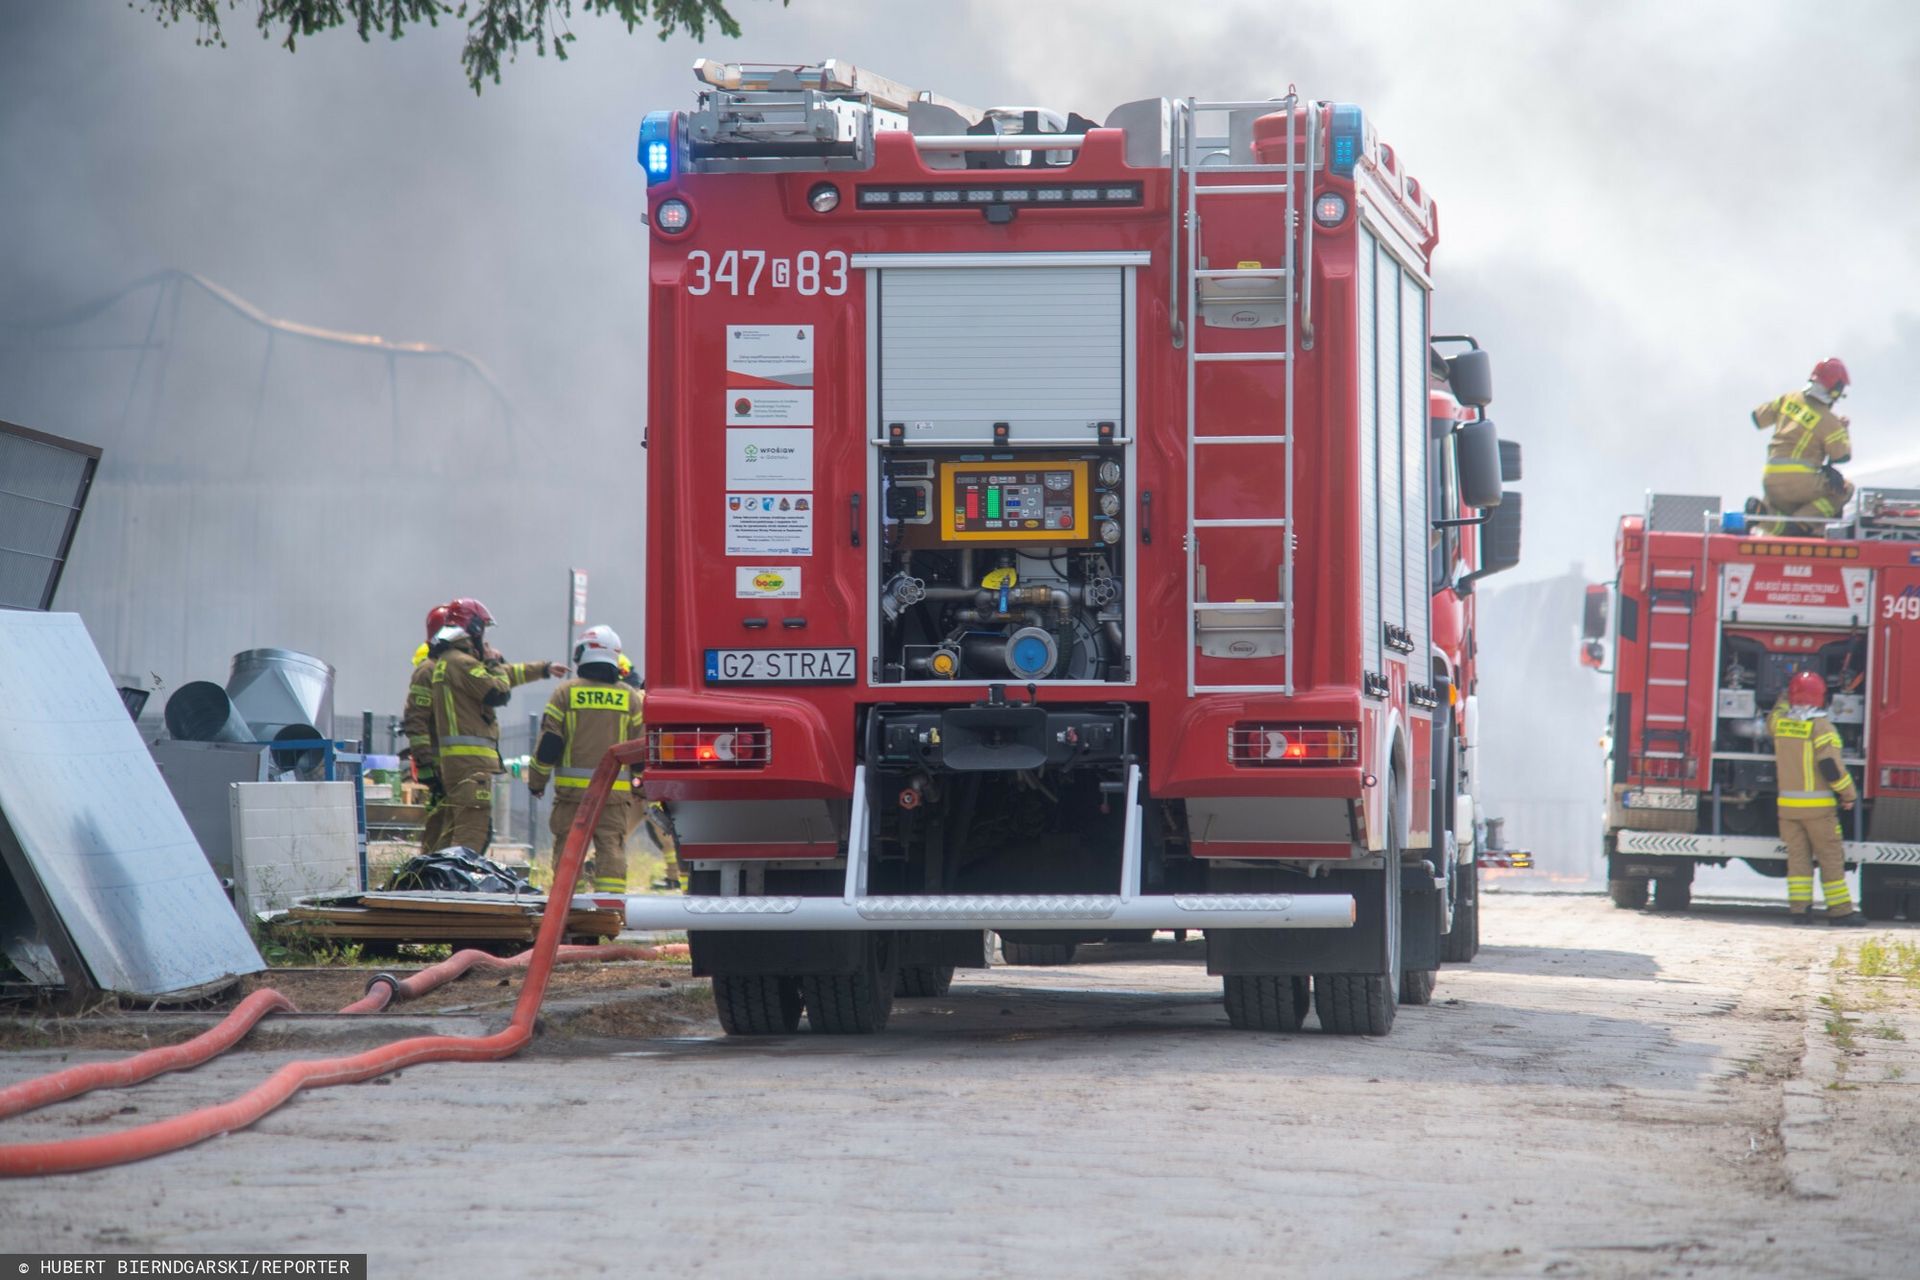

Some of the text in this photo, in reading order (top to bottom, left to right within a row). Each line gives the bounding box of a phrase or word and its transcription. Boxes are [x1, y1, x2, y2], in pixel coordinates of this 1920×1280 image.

[687, 250, 765, 296] 347
[797, 250, 848, 296] 83
[1882, 595, 1920, 620] 349
[723, 653, 754, 678] G2
[766, 652, 851, 678] STRAZ
